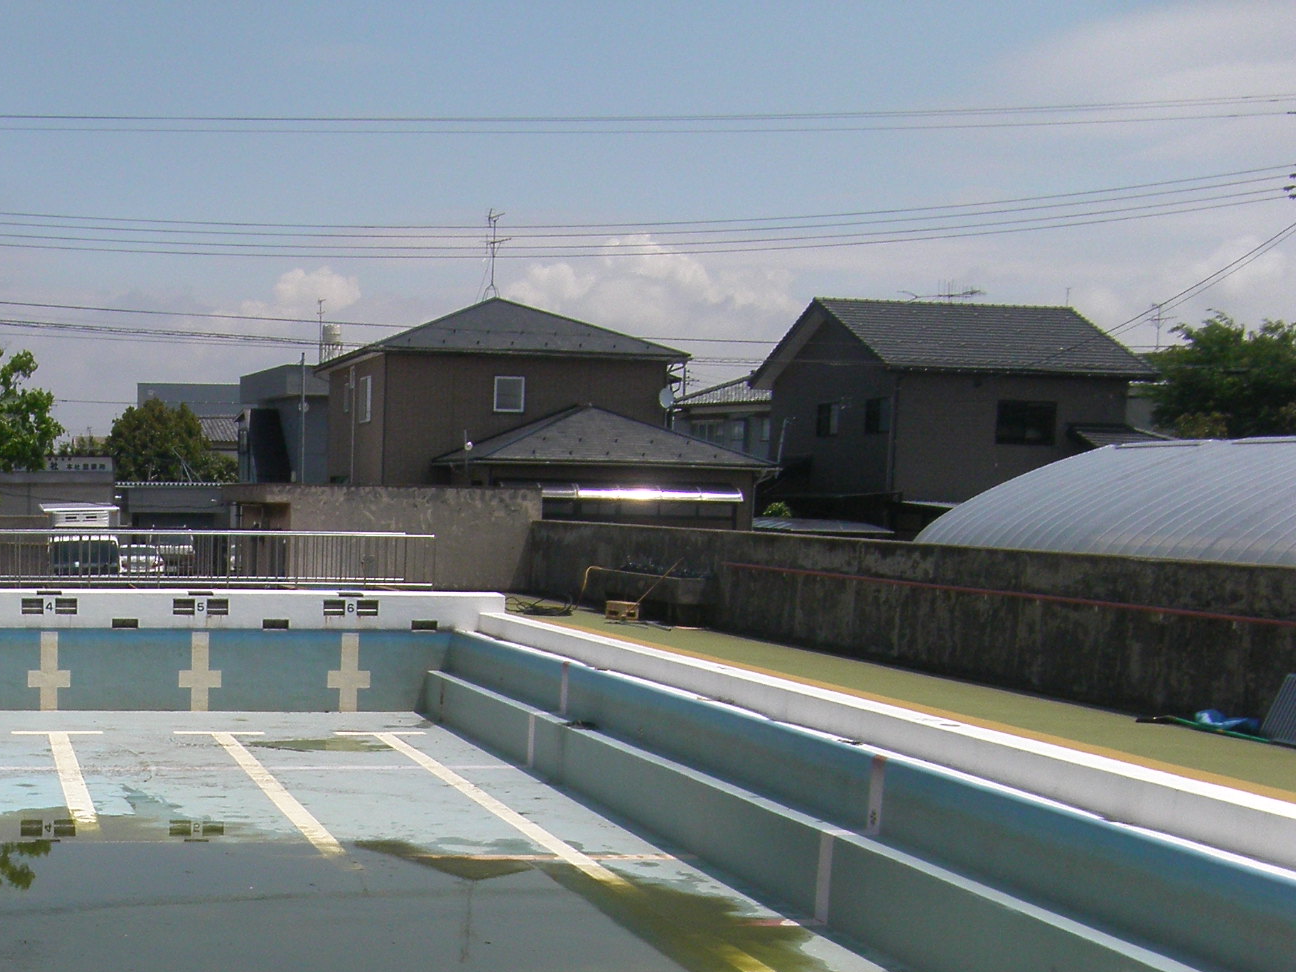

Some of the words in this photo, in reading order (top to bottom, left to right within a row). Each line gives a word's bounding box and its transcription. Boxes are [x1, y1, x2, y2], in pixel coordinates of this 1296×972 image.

[45, 602, 53, 611] 4
[196, 602, 205, 611] 5
[346, 603, 355, 613] 6
